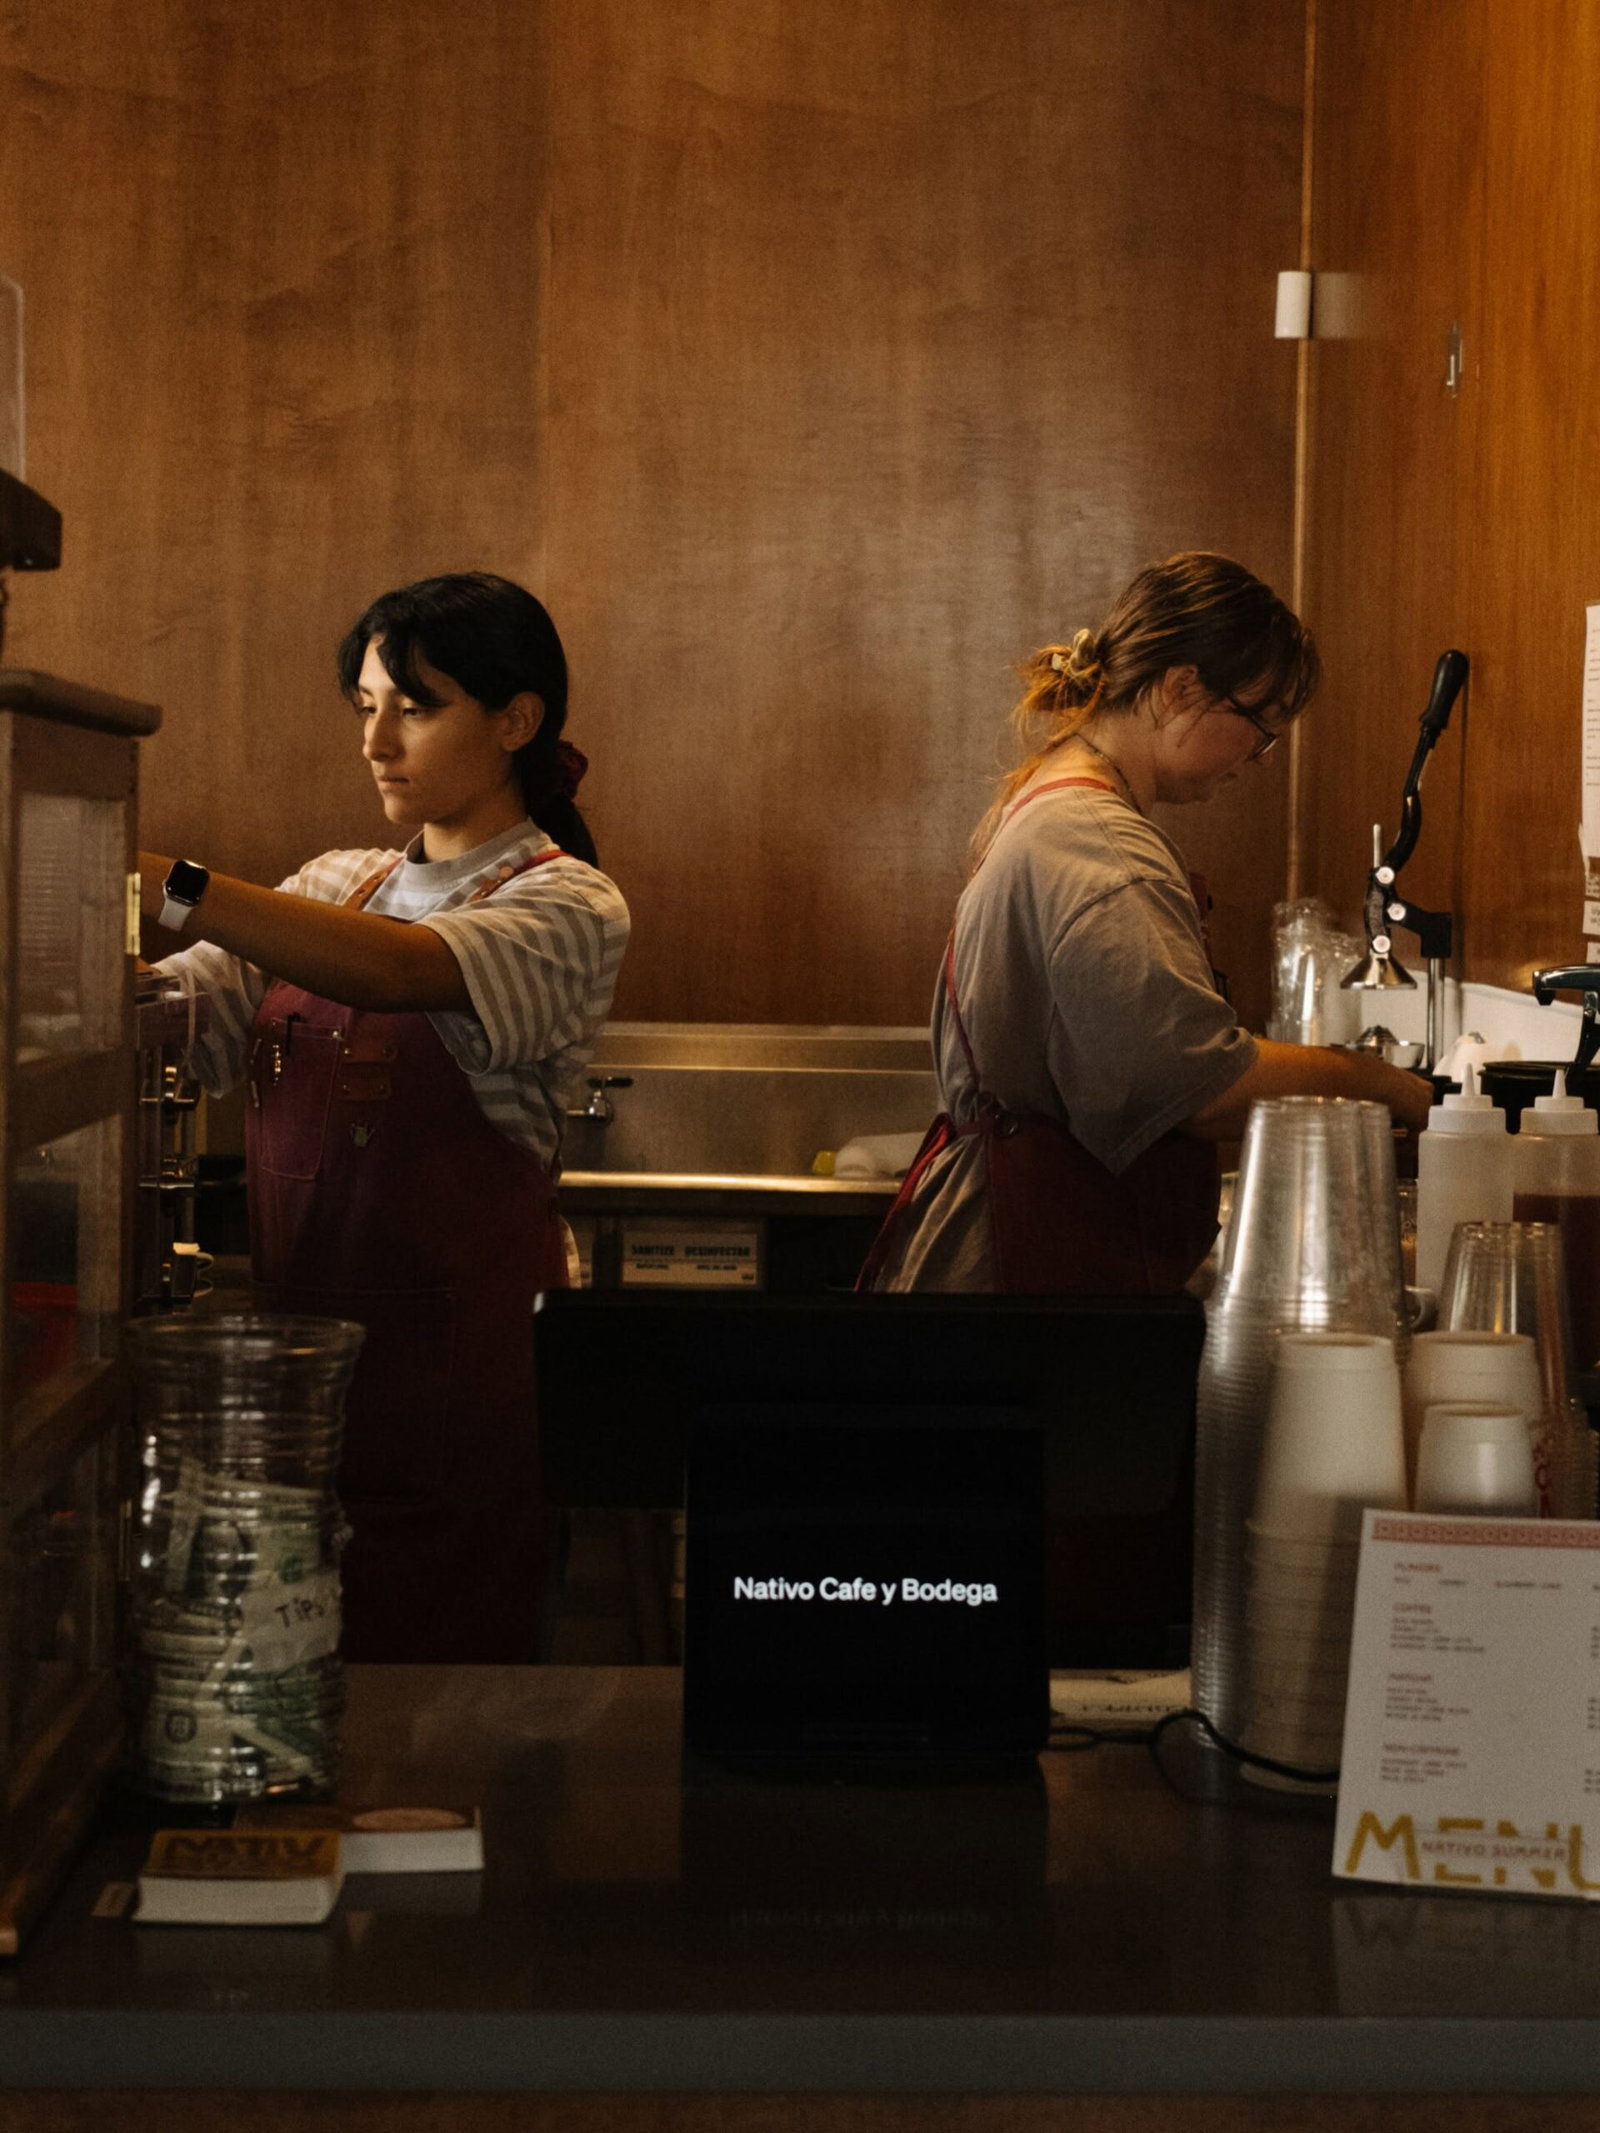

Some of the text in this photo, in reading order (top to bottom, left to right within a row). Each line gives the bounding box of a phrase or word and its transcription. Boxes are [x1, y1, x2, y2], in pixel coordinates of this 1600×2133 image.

[631, 1244, 675, 1256] SANITIZE
[733, 1577, 998, 1607] Nativo Cafe y Bodega
[1421, 1841, 1567, 1862] NATIVO SUMMER
